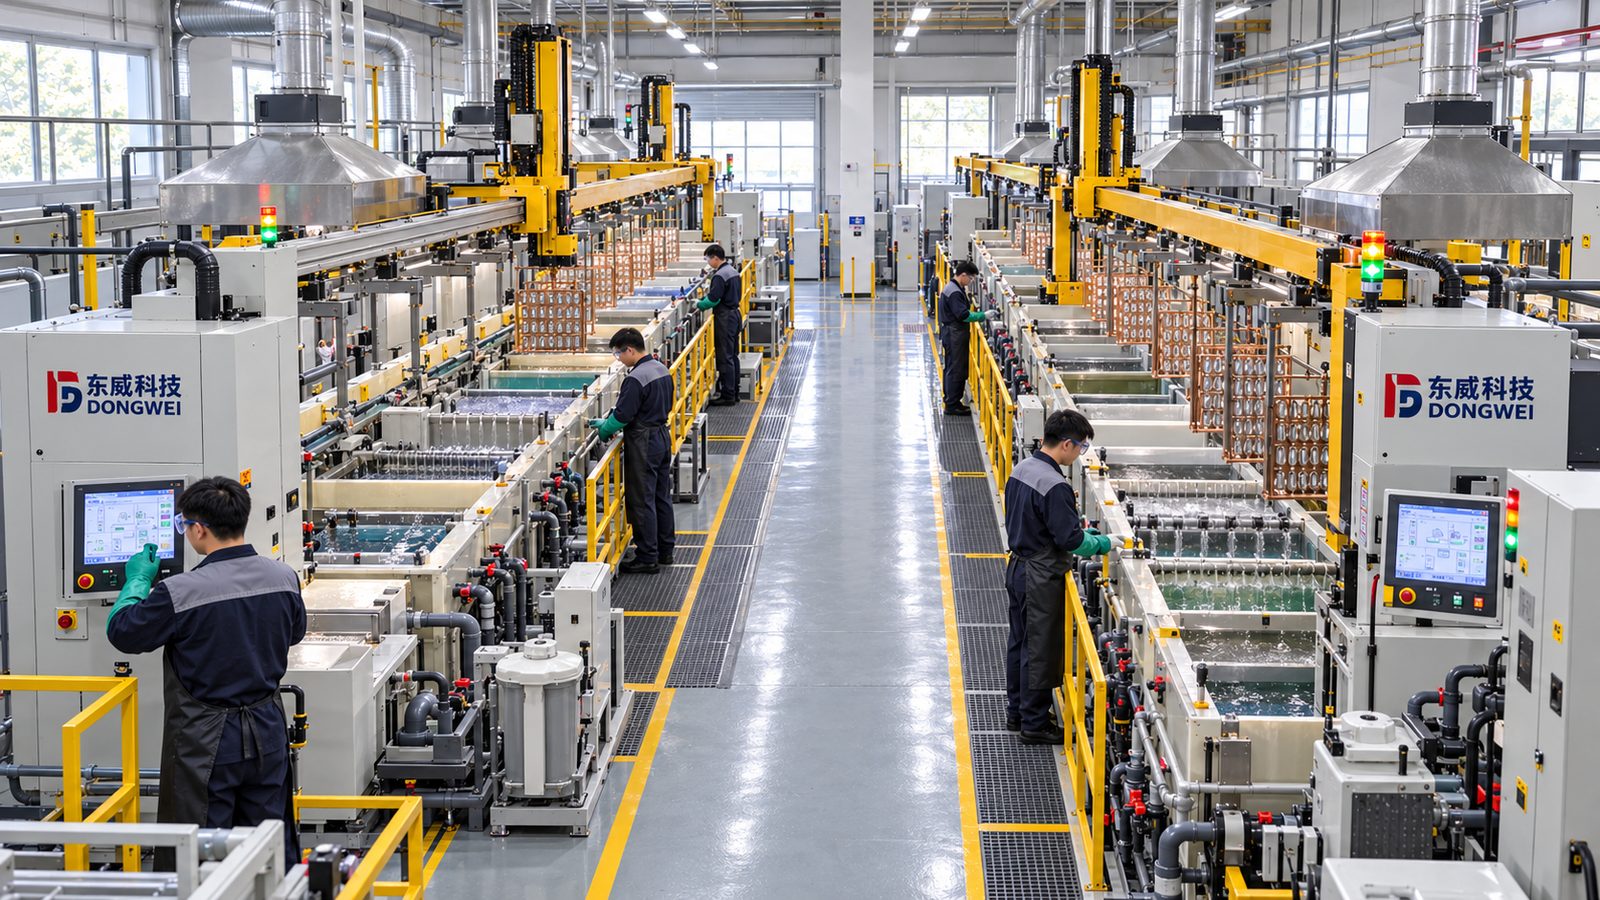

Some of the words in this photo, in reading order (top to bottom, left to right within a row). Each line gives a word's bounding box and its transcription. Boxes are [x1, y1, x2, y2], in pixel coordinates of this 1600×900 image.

[87, 374, 182, 398] 东威科技
[1428, 375, 1535, 401] 东威科技
[87, 399, 182, 416] DONGWEI
[1428, 403, 1534, 420] DONGWEI
